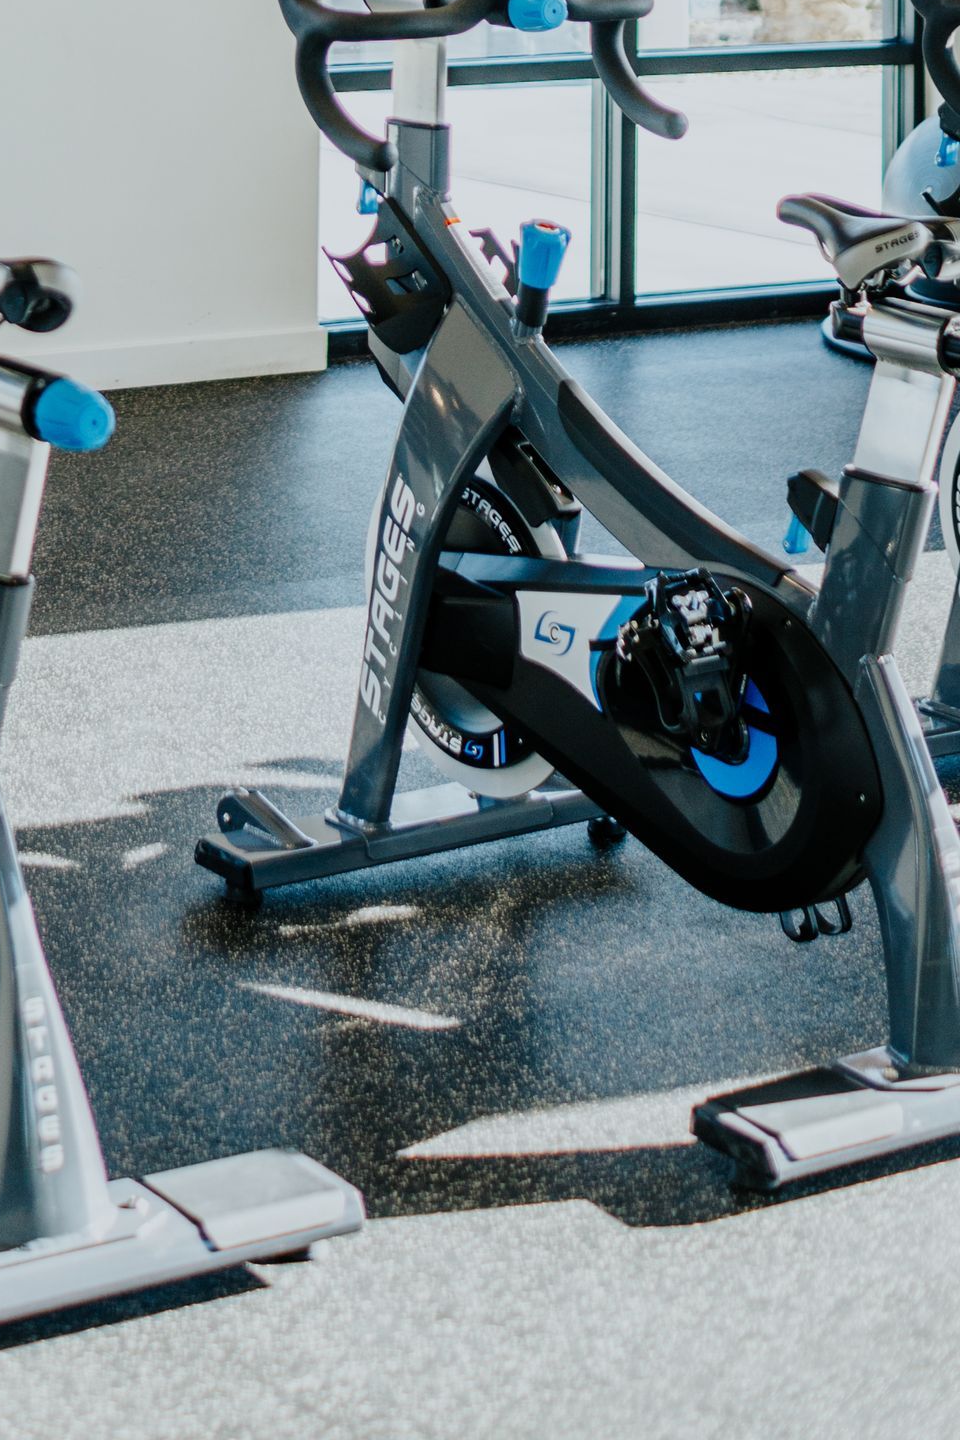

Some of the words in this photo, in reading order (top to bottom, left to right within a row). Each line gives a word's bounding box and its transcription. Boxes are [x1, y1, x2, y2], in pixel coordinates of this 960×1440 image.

[461, 486, 522, 553] STAGES
[359, 472, 415, 718] STAGES
[410, 693, 463, 755] STAGE
